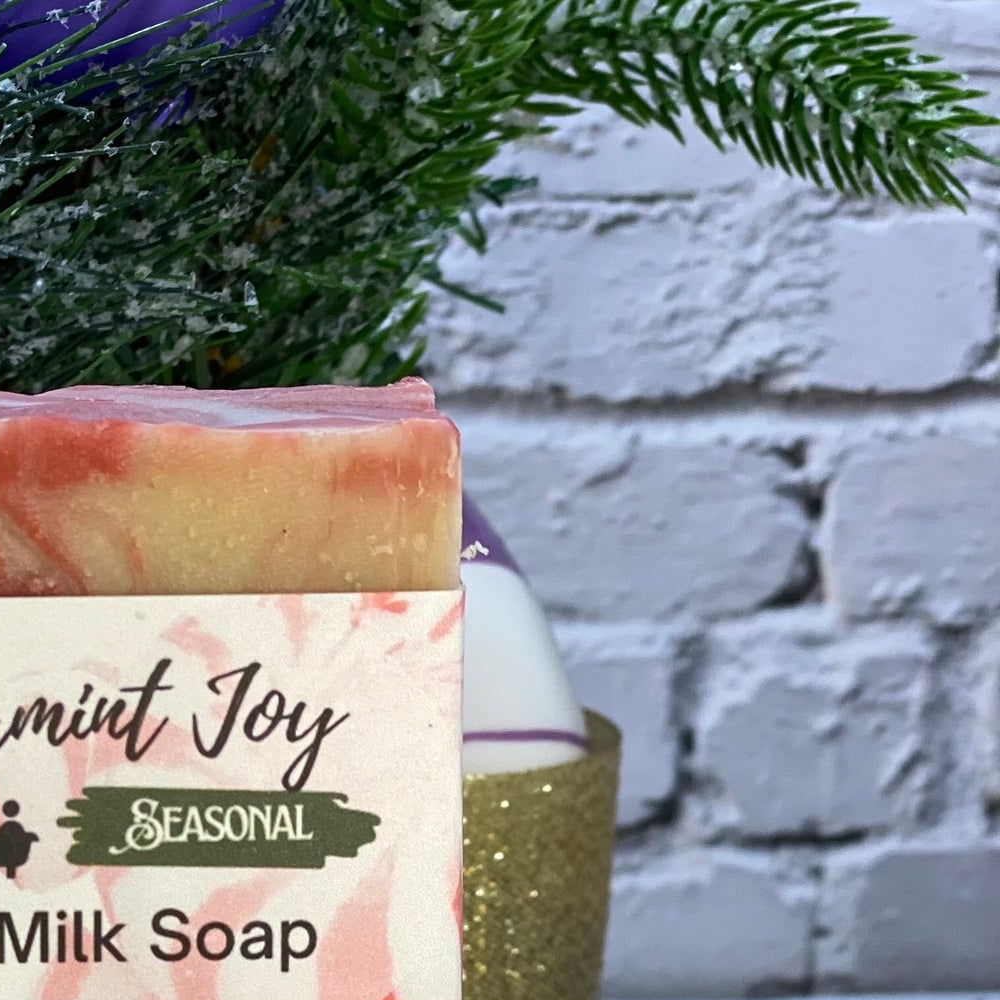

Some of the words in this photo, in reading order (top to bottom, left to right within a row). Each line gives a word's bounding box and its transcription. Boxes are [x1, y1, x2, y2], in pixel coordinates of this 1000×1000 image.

[192, 662, 349, 794] Joy
[108, 797, 314, 855] SEASONAL
[150, 908, 317, 973] Soap
